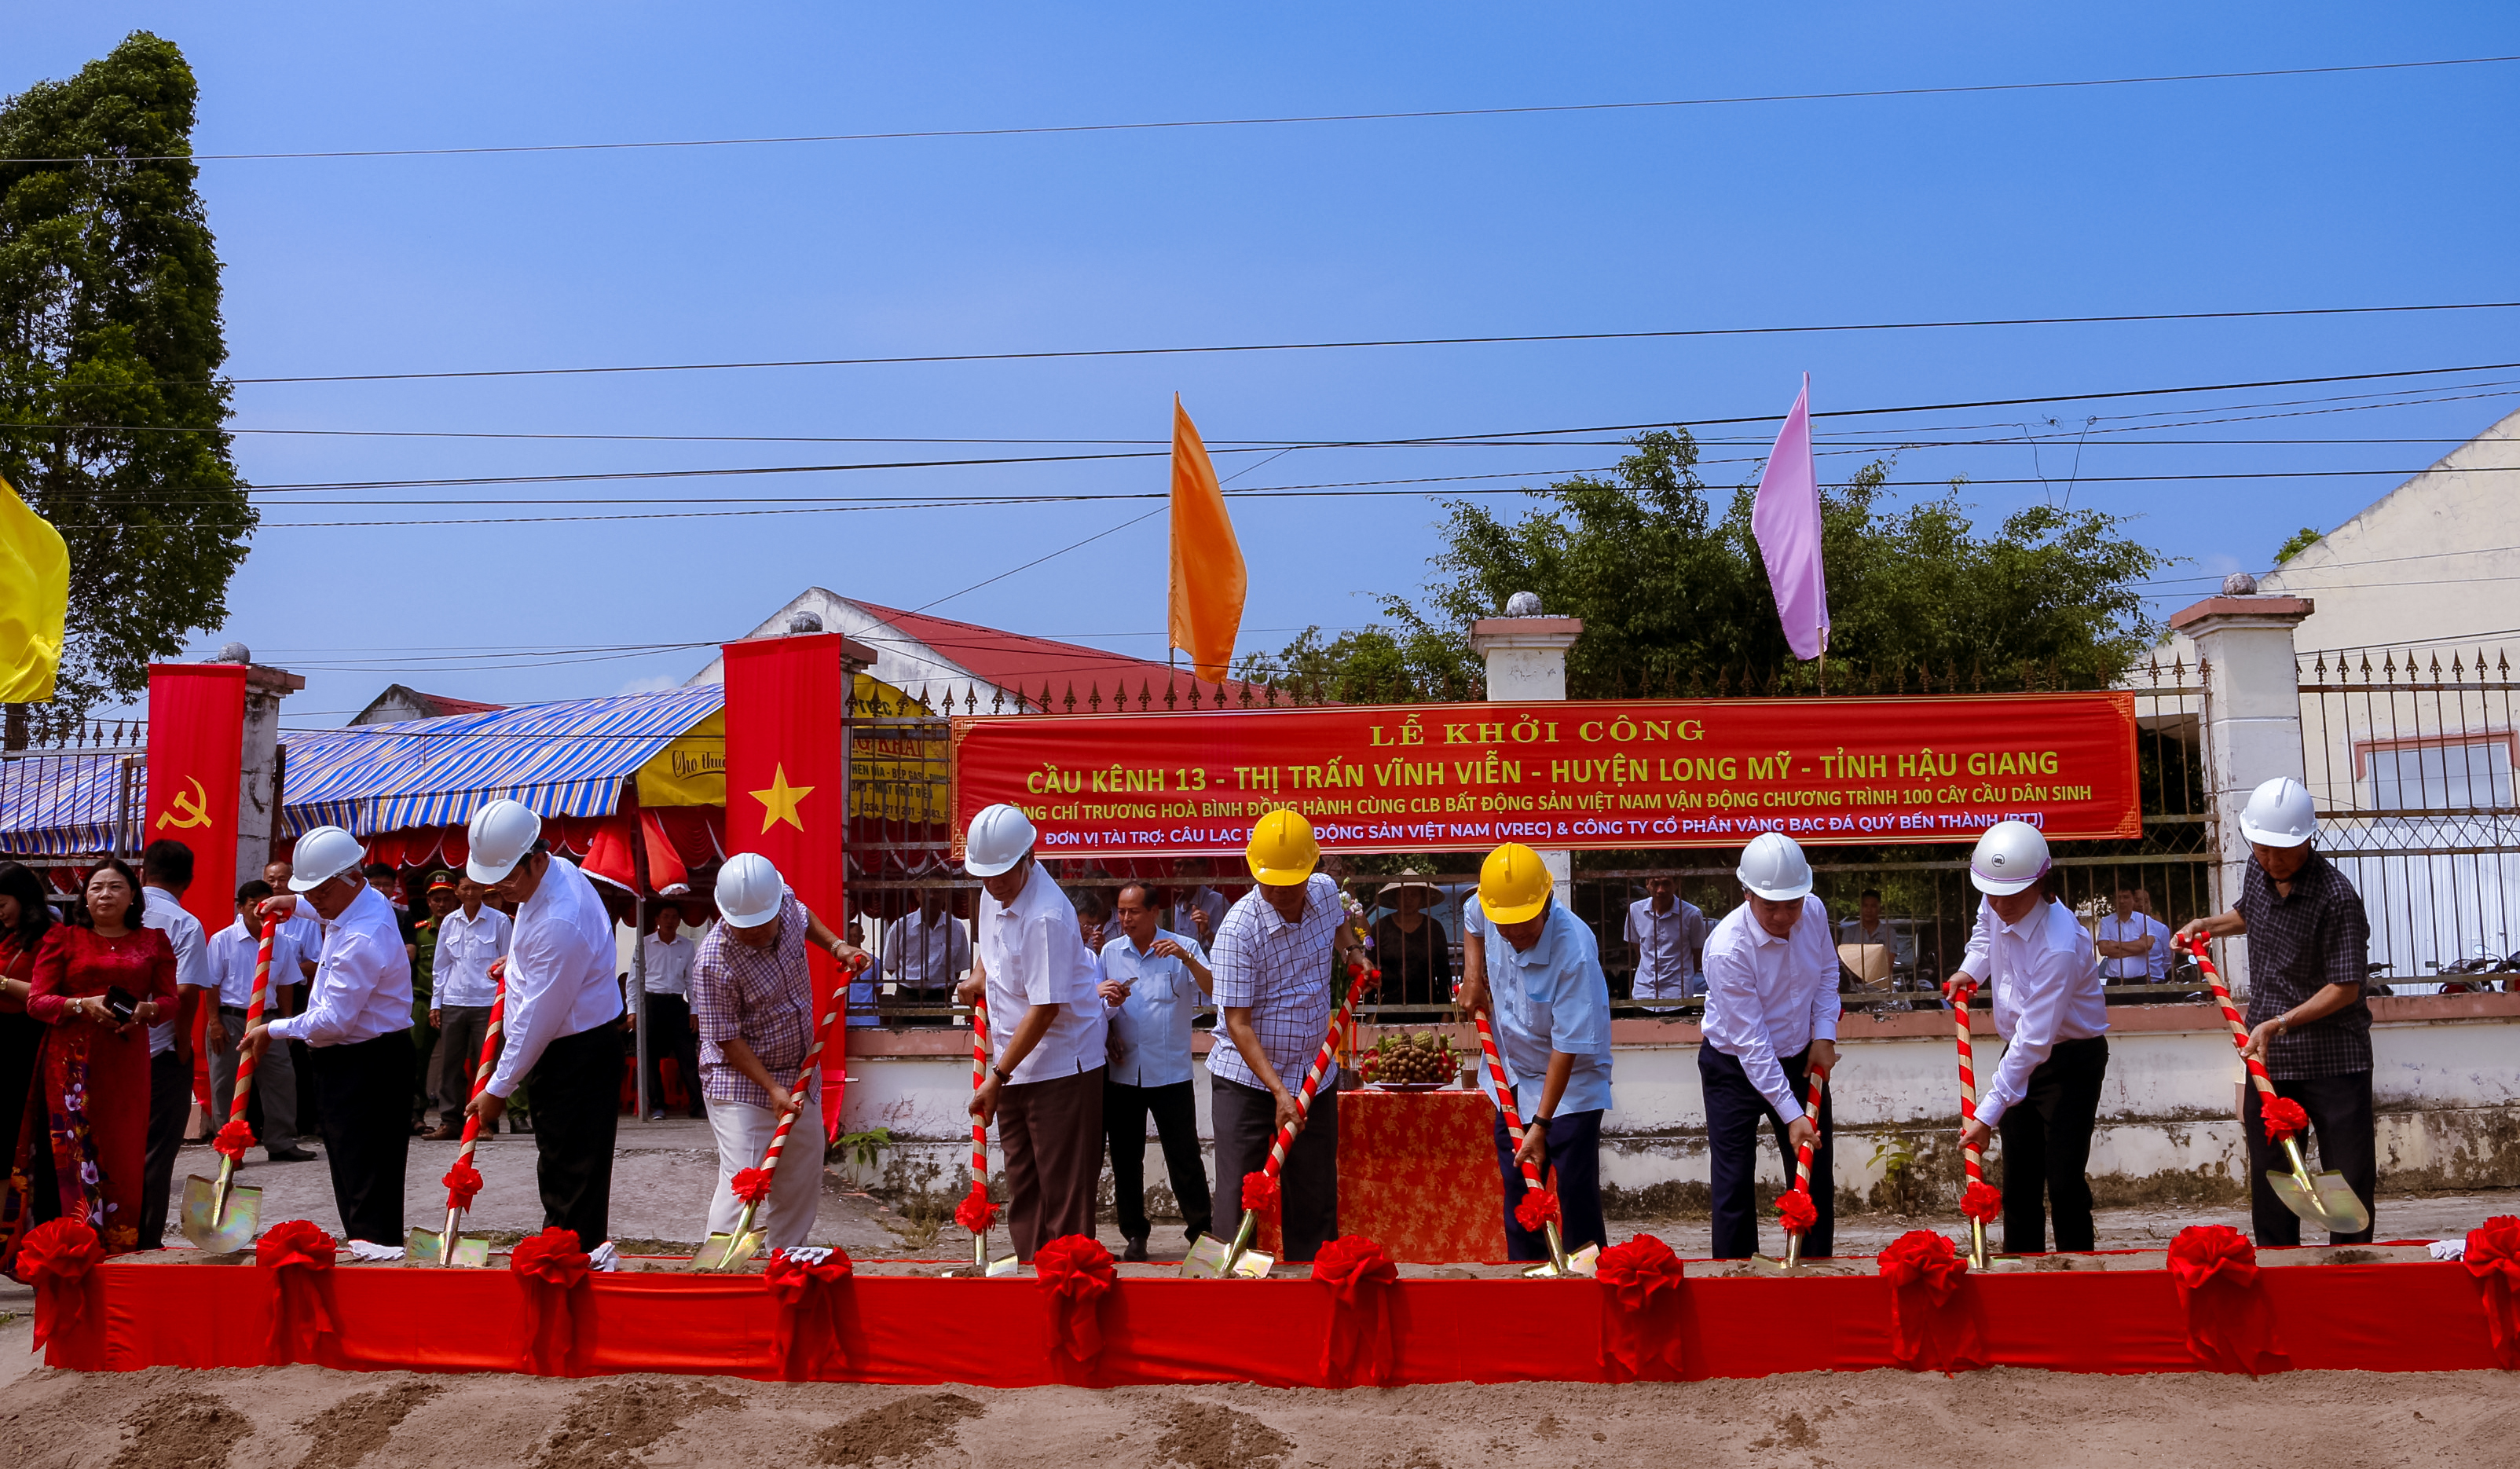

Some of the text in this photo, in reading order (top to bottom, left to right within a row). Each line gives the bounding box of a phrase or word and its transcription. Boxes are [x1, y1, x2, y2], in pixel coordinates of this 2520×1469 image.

[1369, 713, 1705, 746] LỄ KHỞI CÔNG
[672, 750, 698, 778] Cho
[1027, 762, 1082, 794] CẦU
[1092, 763, 1165, 793] KÊNH
[1176, 767, 1207, 791] 13
[1234, 766, 1279, 795] THỊ
[1288, 756, 1364, 789] TRẤN
[1374, 756, 1445, 786] VĨNH
[1454, 750, 1521, 784] VIỄN
[1551, 752, 1648, 788] HUYỆN
[1659, 756, 1737, 782] LONG
[1749, 751, 1793, 779] MỸ
[1819, 746, 1887, 778] TỈNH
[1898, 747, 1957, 782] HẬU
[1967, 751, 2058, 777] GIANG
[1010, 800, 1047, 821] NG
[1051, 800, 1079, 820] CHÍ
[1082, 803, 1156, 819] TRƯƠNG
[1161, 799, 1198, 819] HOÀ
[1203, 798, 1243, 818] BÌNH
[1303, 796, 1352, 815] HÀNH
[1357, 794, 1406, 815] CÙNG
[1411, 797, 1441, 813] CLB
[1446, 790, 1478, 812] BẤT
[1481, 793, 1533, 815] ĐỘNG
[1538, 789, 1573, 811] SẢN
[1577, 790, 1615, 813] VIỆT
[1619, 794, 1661, 809] NAM
[1665, 789, 1702, 811] VẬN
[1706, 789, 1759, 811] ĐỘNG
[1763, 789, 1841, 808] CHƯƠNG
[1845, 786, 1898, 806] TRÌNH
[1903, 789, 1932, 805] 100
[1937, 785, 1969, 804] CÂY
[1972, 782, 2006, 803] CẦU
[2011, 782, 2047, 802] DÂN
[2052, 785, 2092, 801] SINH
[1045, 830, 1080, 844] ĐƠN
[1083, 832, 1098, 847] VỊ
[1102, 829, 1126, 844] TÀI
[1130, 830, 1165, 846] TRỢ:
[1170, 826, 1204, 844] CÂU
[1210, 828, 1242, 845] LẠC
[1313, 822, 1364, 843] ĐỘNG
[1368, 820, 1403, 839] SẢN
[1408, 822, 1446, 841] VIỆT
[1450, 823, 1489, 837] NAM
[1495, 821, 1551, 840] (VREC)
[1556, 822, 1569, 836] &
[1573, 818, 1623, 835] CÔNG
[1627, 820, 1649, 834] TY
[1652, 815, 1678, 833] CỔ
[1682, 815, 1731, 833] PHẦN
[1735, 816, 1785, 832] VÀNG
[1789, 817, 1825, 834] BẠC
[1829, 814, 1855, 830] ĐÁ
[1859, 812, 1895, 831] QUÝ
[1899, 811, 1935, 830] BẾN
[1939, 811, 1998, 828] THÀNH
